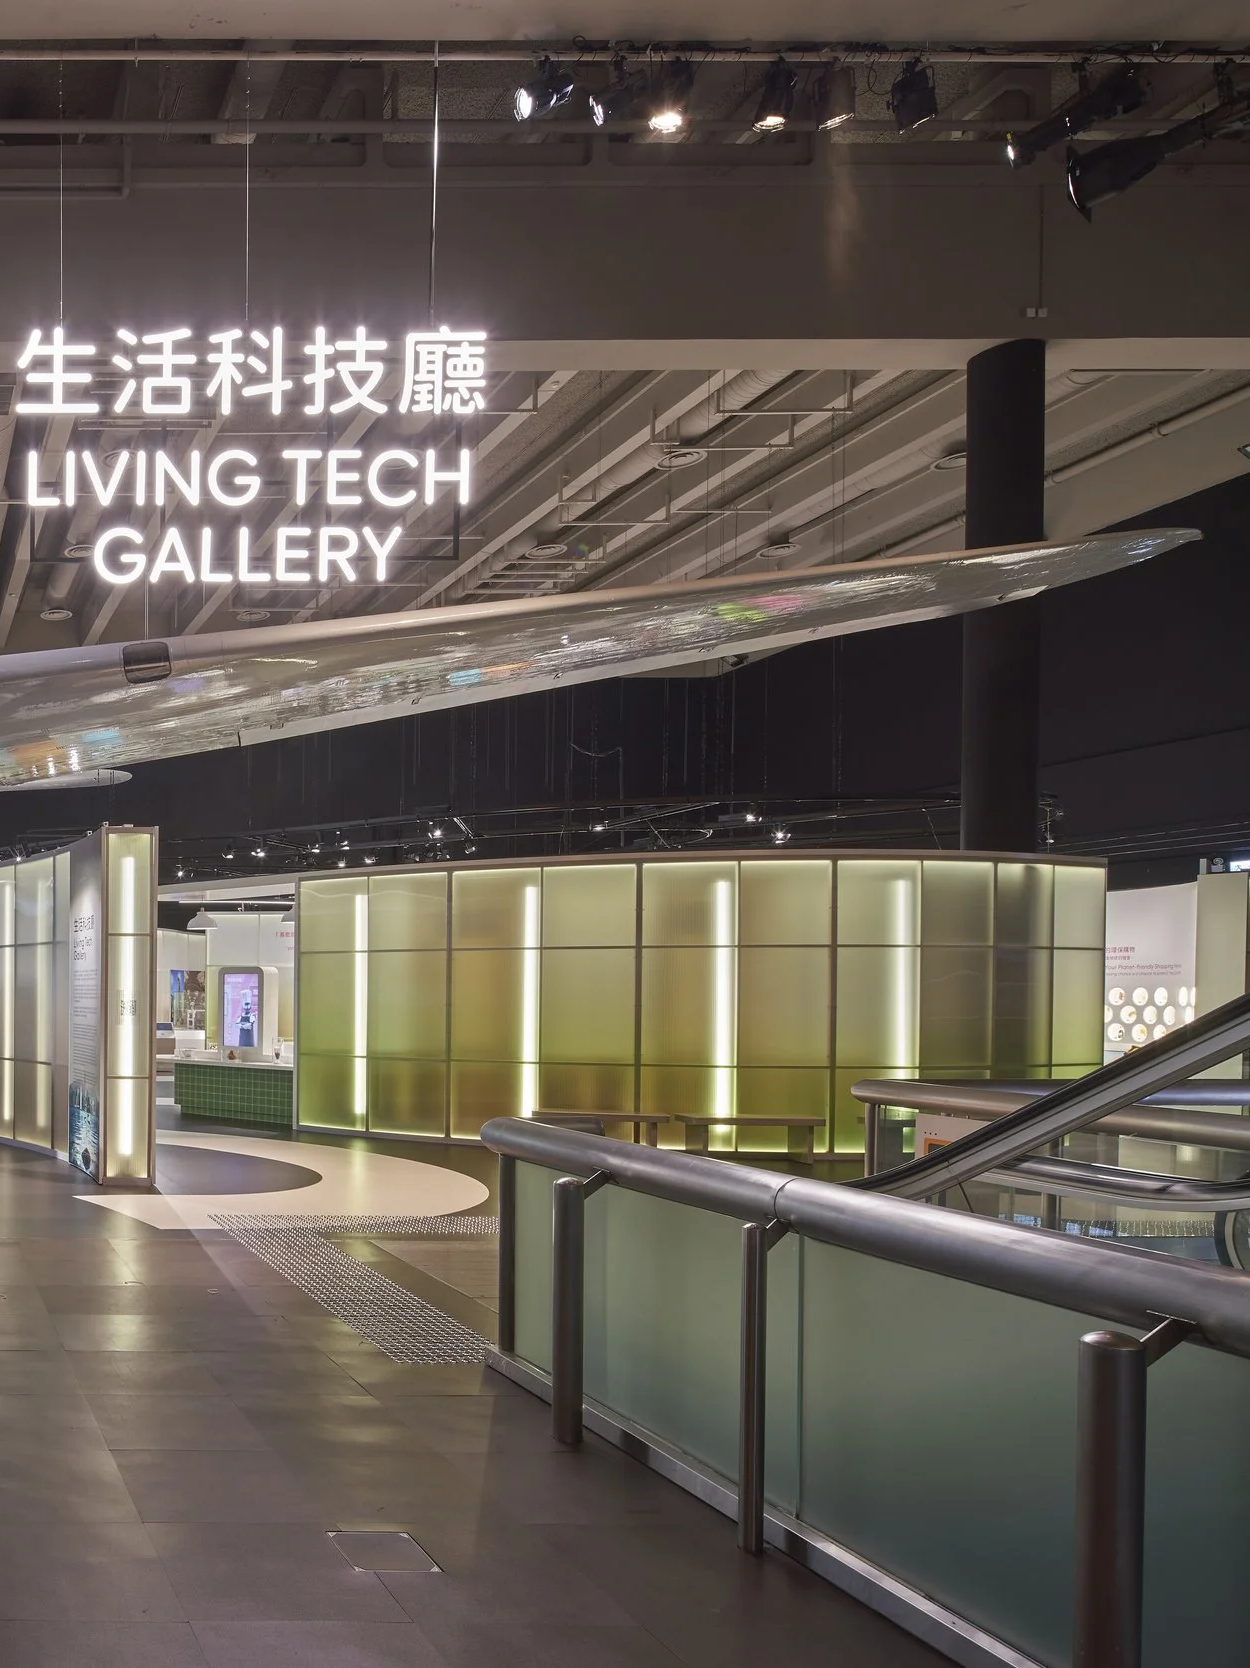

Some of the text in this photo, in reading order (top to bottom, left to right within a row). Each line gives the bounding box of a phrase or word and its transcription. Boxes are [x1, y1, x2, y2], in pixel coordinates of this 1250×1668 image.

[15, 325, 488, 416] 生活科技廳
[26, 447, 472, 508] LIVING TECH
[92, 525, 403, 586] GALLERY
